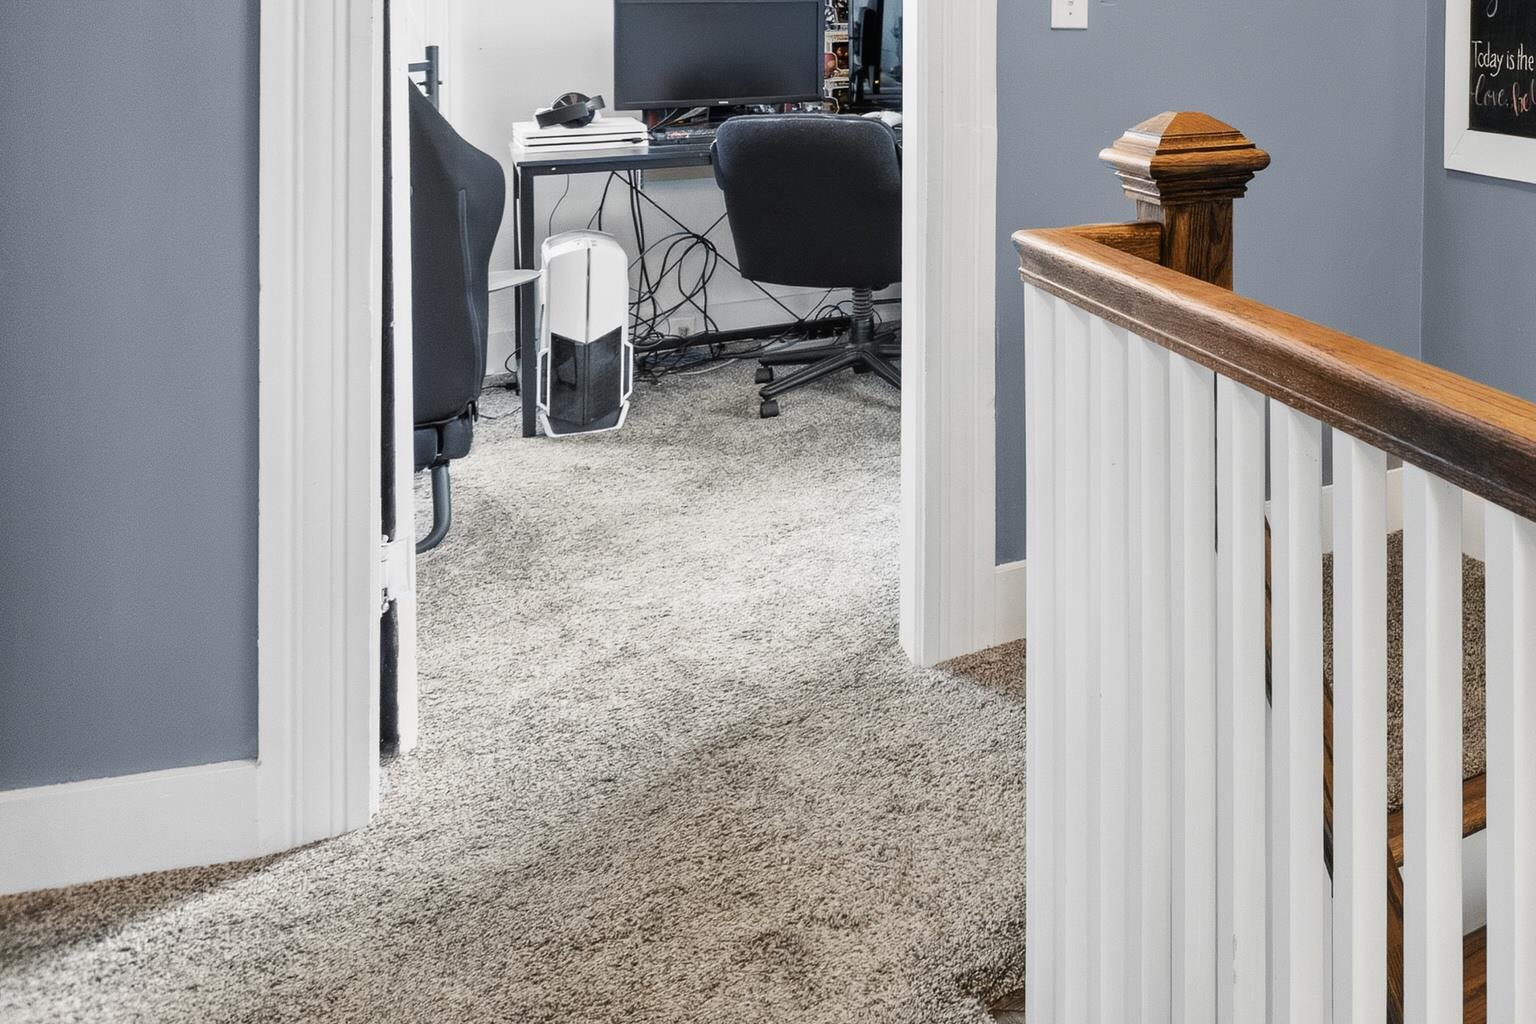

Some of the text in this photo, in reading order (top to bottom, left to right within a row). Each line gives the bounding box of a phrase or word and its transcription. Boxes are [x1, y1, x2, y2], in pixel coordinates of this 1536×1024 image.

[1472, 40, 1504, 78] Today
[1506, 48, 1516, 71] is
[1516, 42, 1534, 72] the
